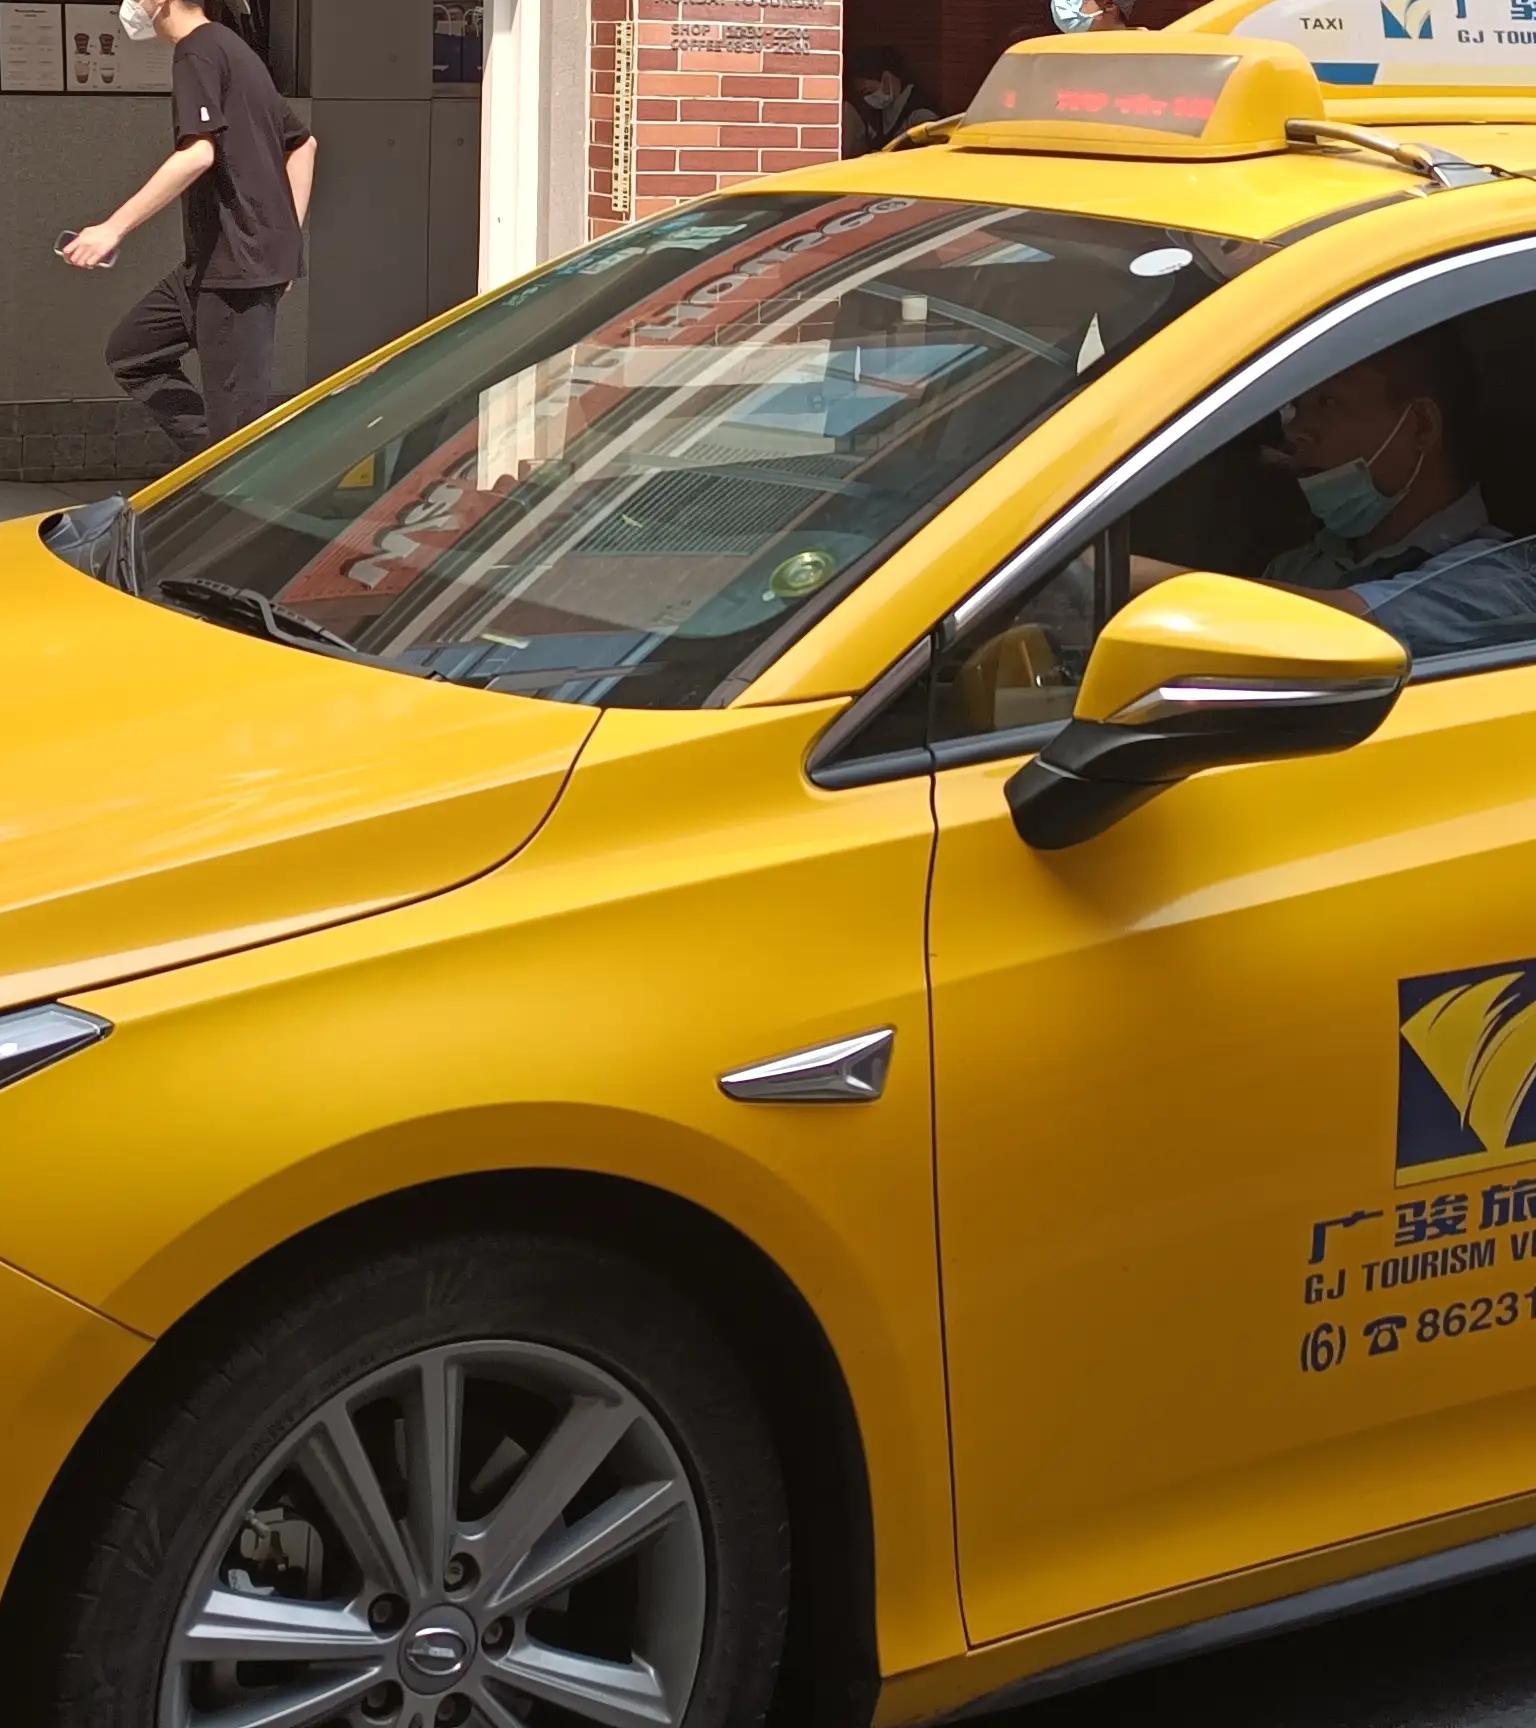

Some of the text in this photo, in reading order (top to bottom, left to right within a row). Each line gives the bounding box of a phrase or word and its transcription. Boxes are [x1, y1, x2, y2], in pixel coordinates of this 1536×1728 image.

[1299, 16, 1345, 32] TAXI
[1457, 29, 1485, 45] GJ
[1304, 1268, 1347, 1306] GJ
[1362, 1238, 1496, 1292] TOURISM
[1300, 1321, 1347, 1374] (6)
